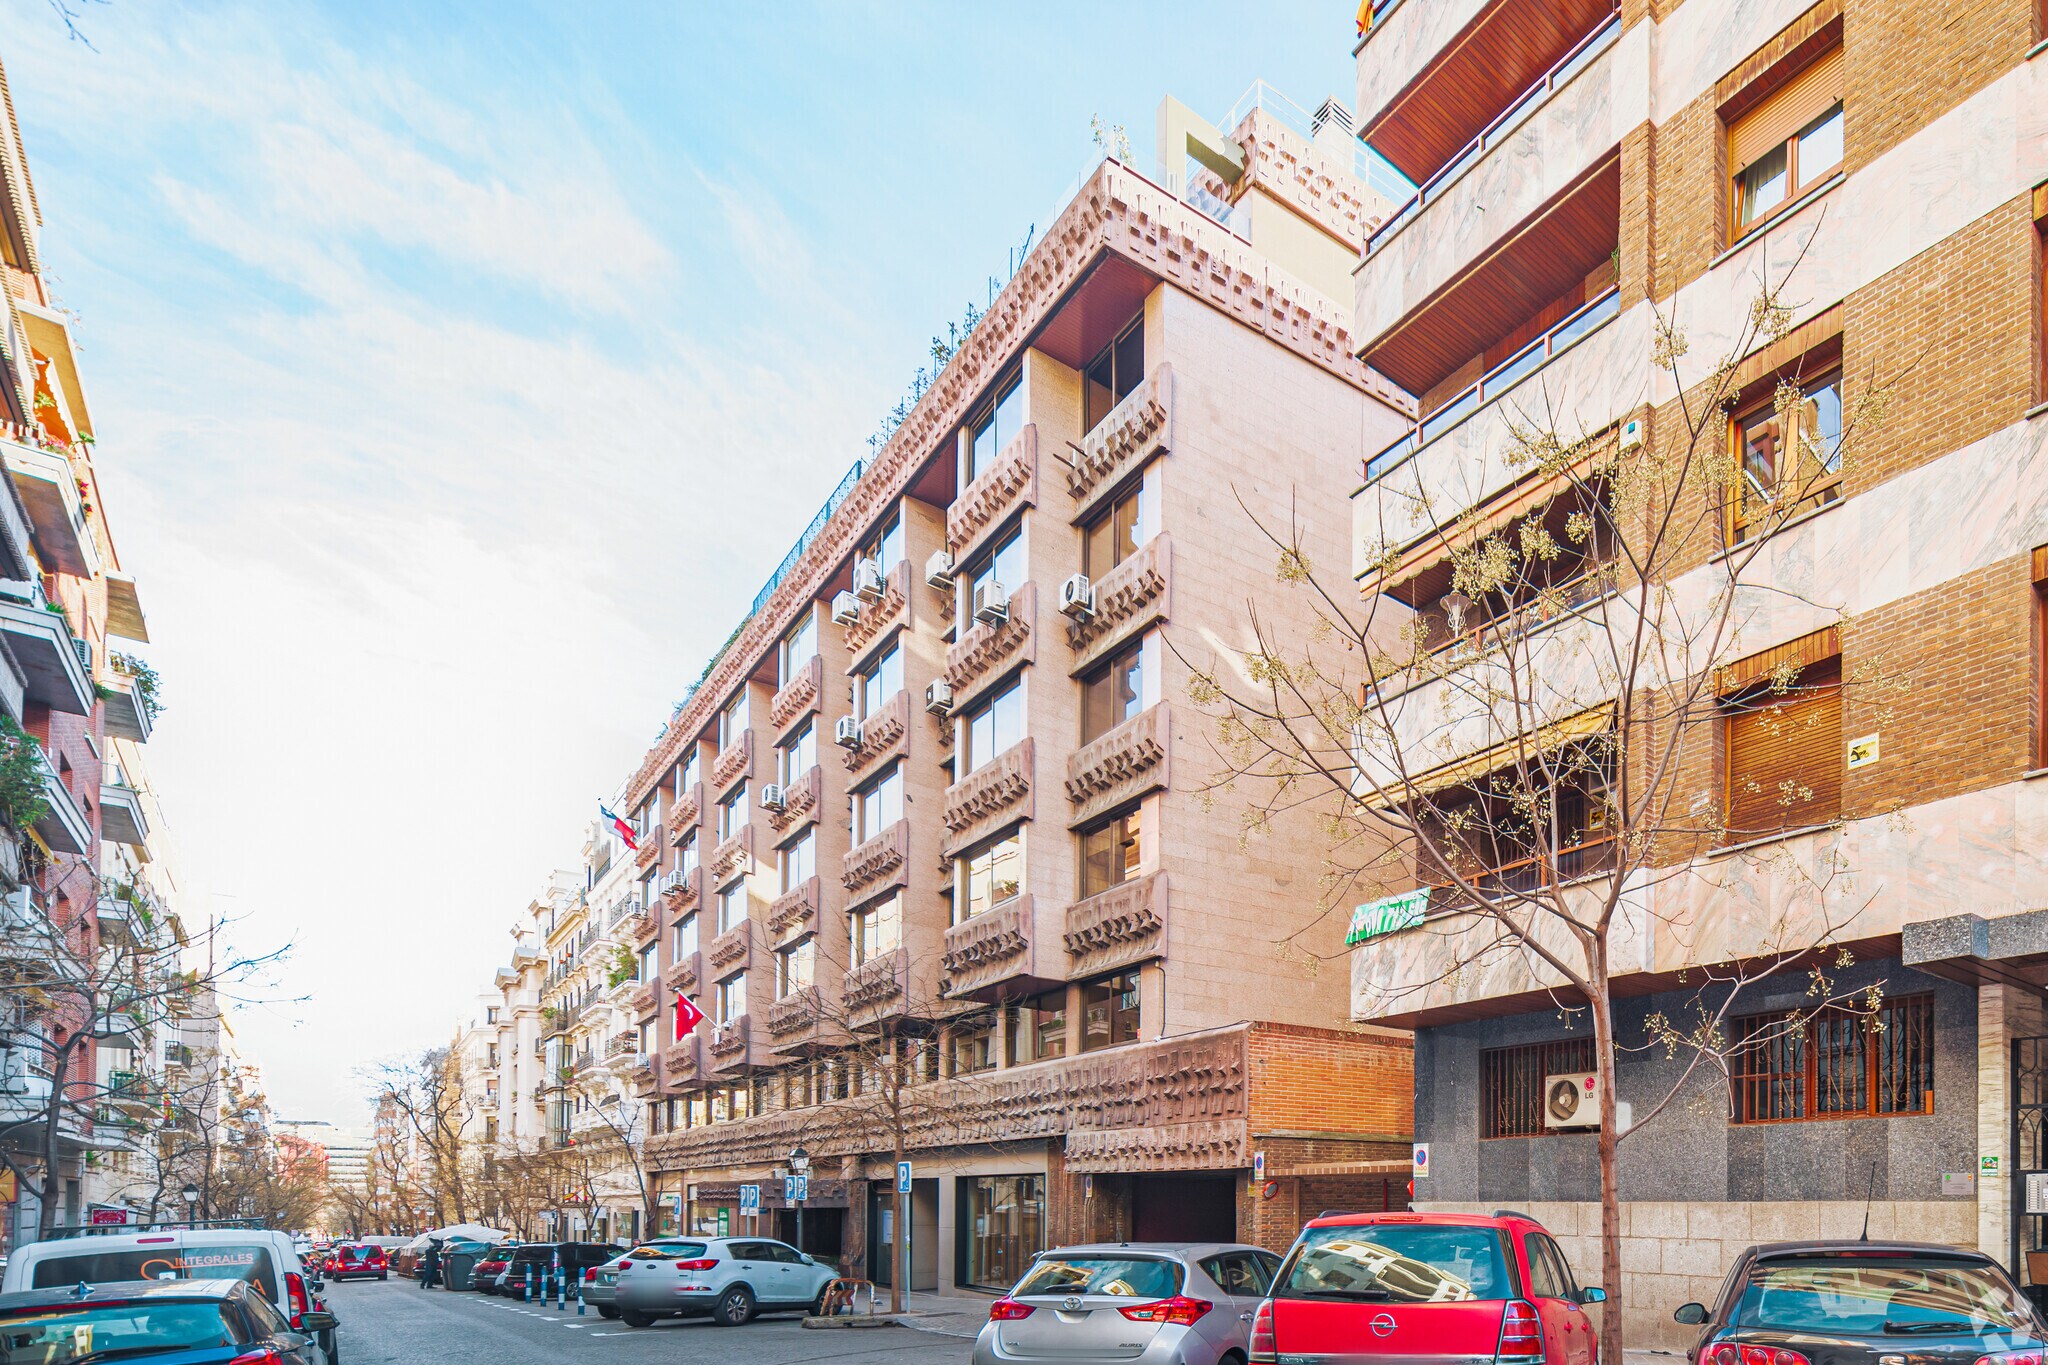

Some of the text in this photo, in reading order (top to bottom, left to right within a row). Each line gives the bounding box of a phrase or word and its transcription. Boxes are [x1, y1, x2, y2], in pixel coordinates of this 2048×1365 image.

[900, 1166, 907, 1189] P
[787, 1179, 793, 1197] P
[798, 1178, 804, 1197] P
[741, 1188, 746, 1207] P
[750, 1188, 756, 1206] P
[175, 1253, 254, 1266] INTEGRALES
